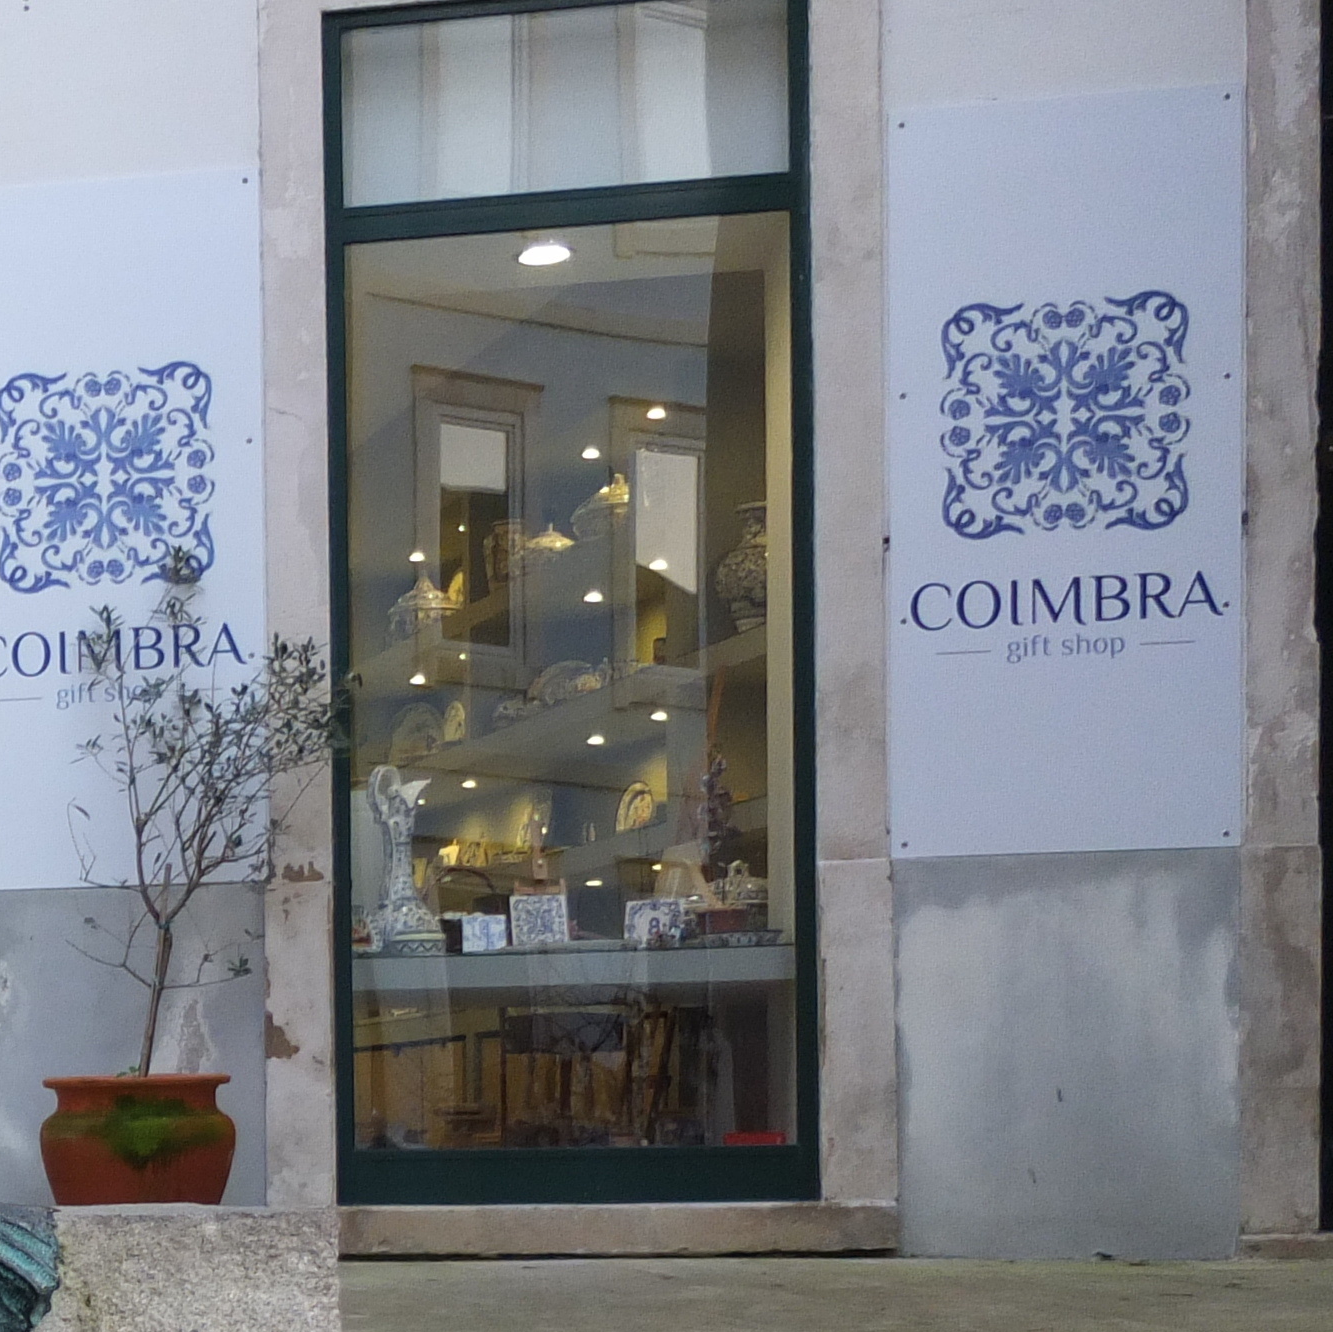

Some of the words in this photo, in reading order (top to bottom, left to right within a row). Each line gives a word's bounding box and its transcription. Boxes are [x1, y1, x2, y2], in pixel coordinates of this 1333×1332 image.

[910, 569, 1225, 631] COIMBRA
[1006, 634, 1051, 664] gift
[1061, 633, 1126, 659] shop
[55, 682, 95, 710] gift
